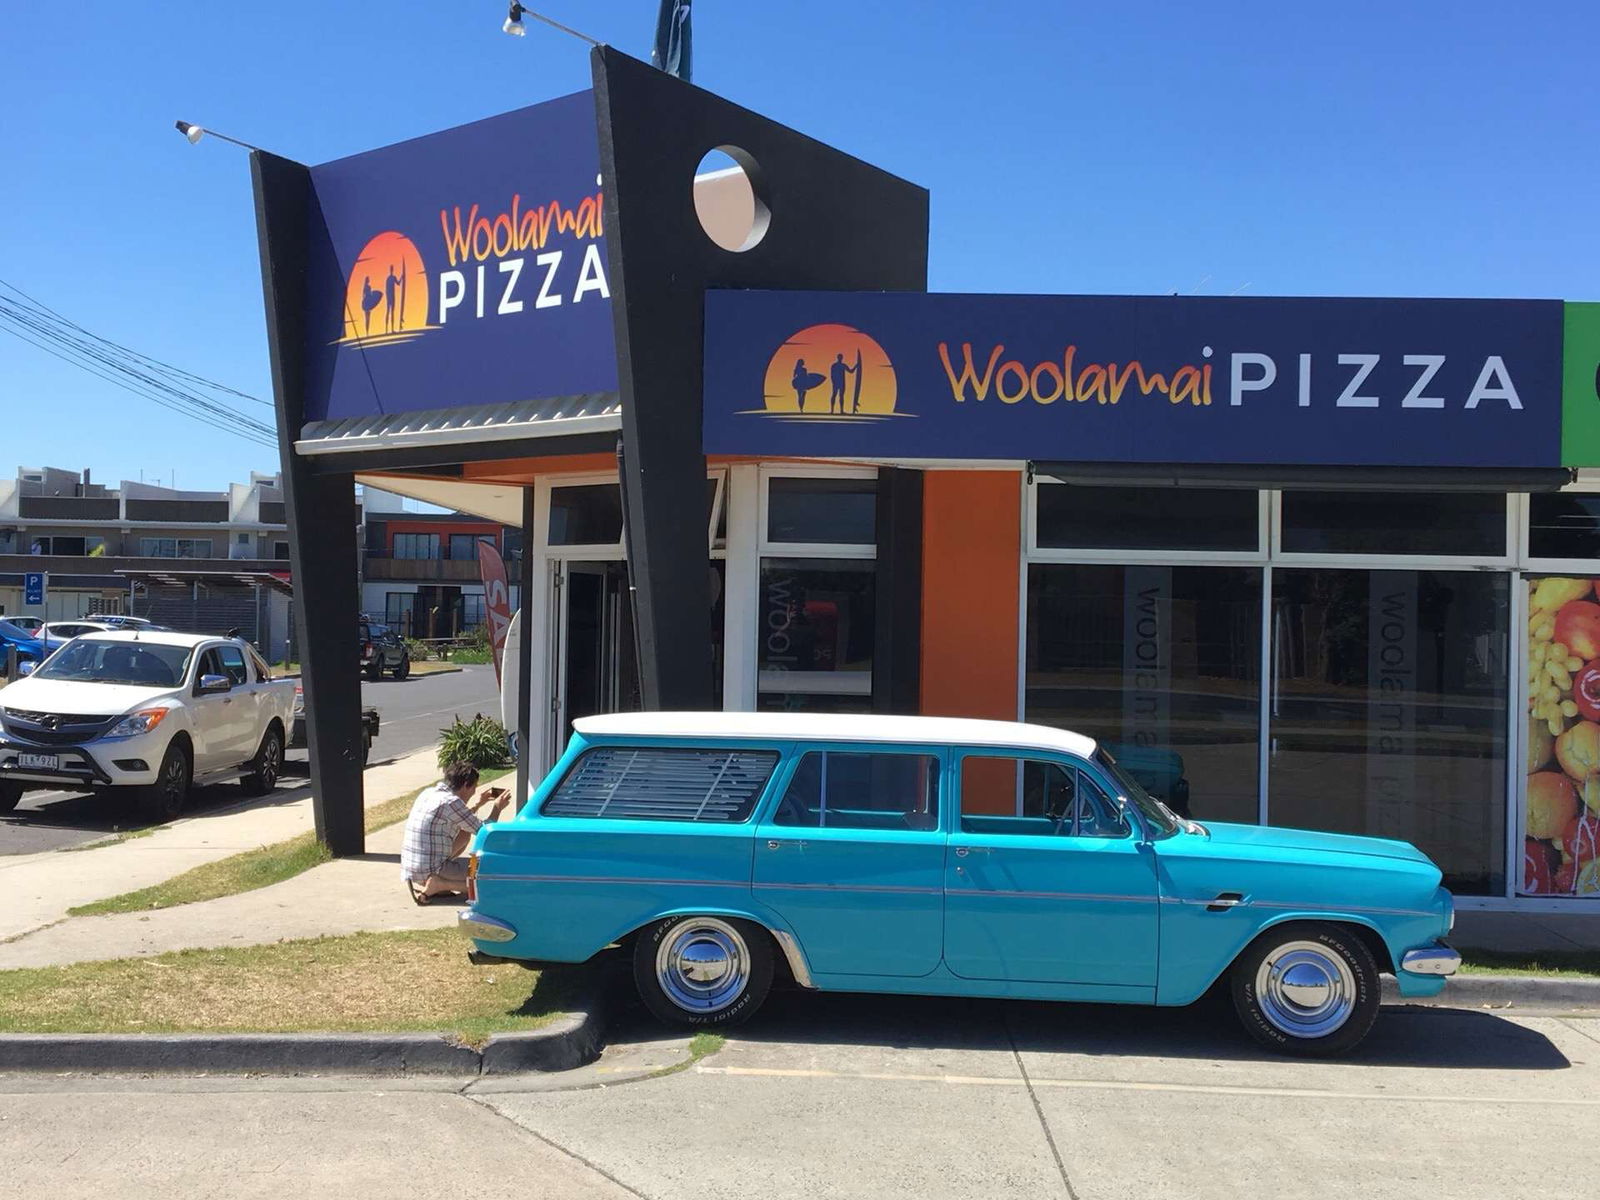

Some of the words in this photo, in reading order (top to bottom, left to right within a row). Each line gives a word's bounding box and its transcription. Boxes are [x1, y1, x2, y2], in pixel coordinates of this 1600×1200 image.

[440, 173, 604, 267] Woolamai
[439, 244, 610, 324] PIZZA
[938, 343, 1213, 407] Woolamai
[1230, 353, 1523, 410] PIZZA
[30, 576, 38, 586] P
